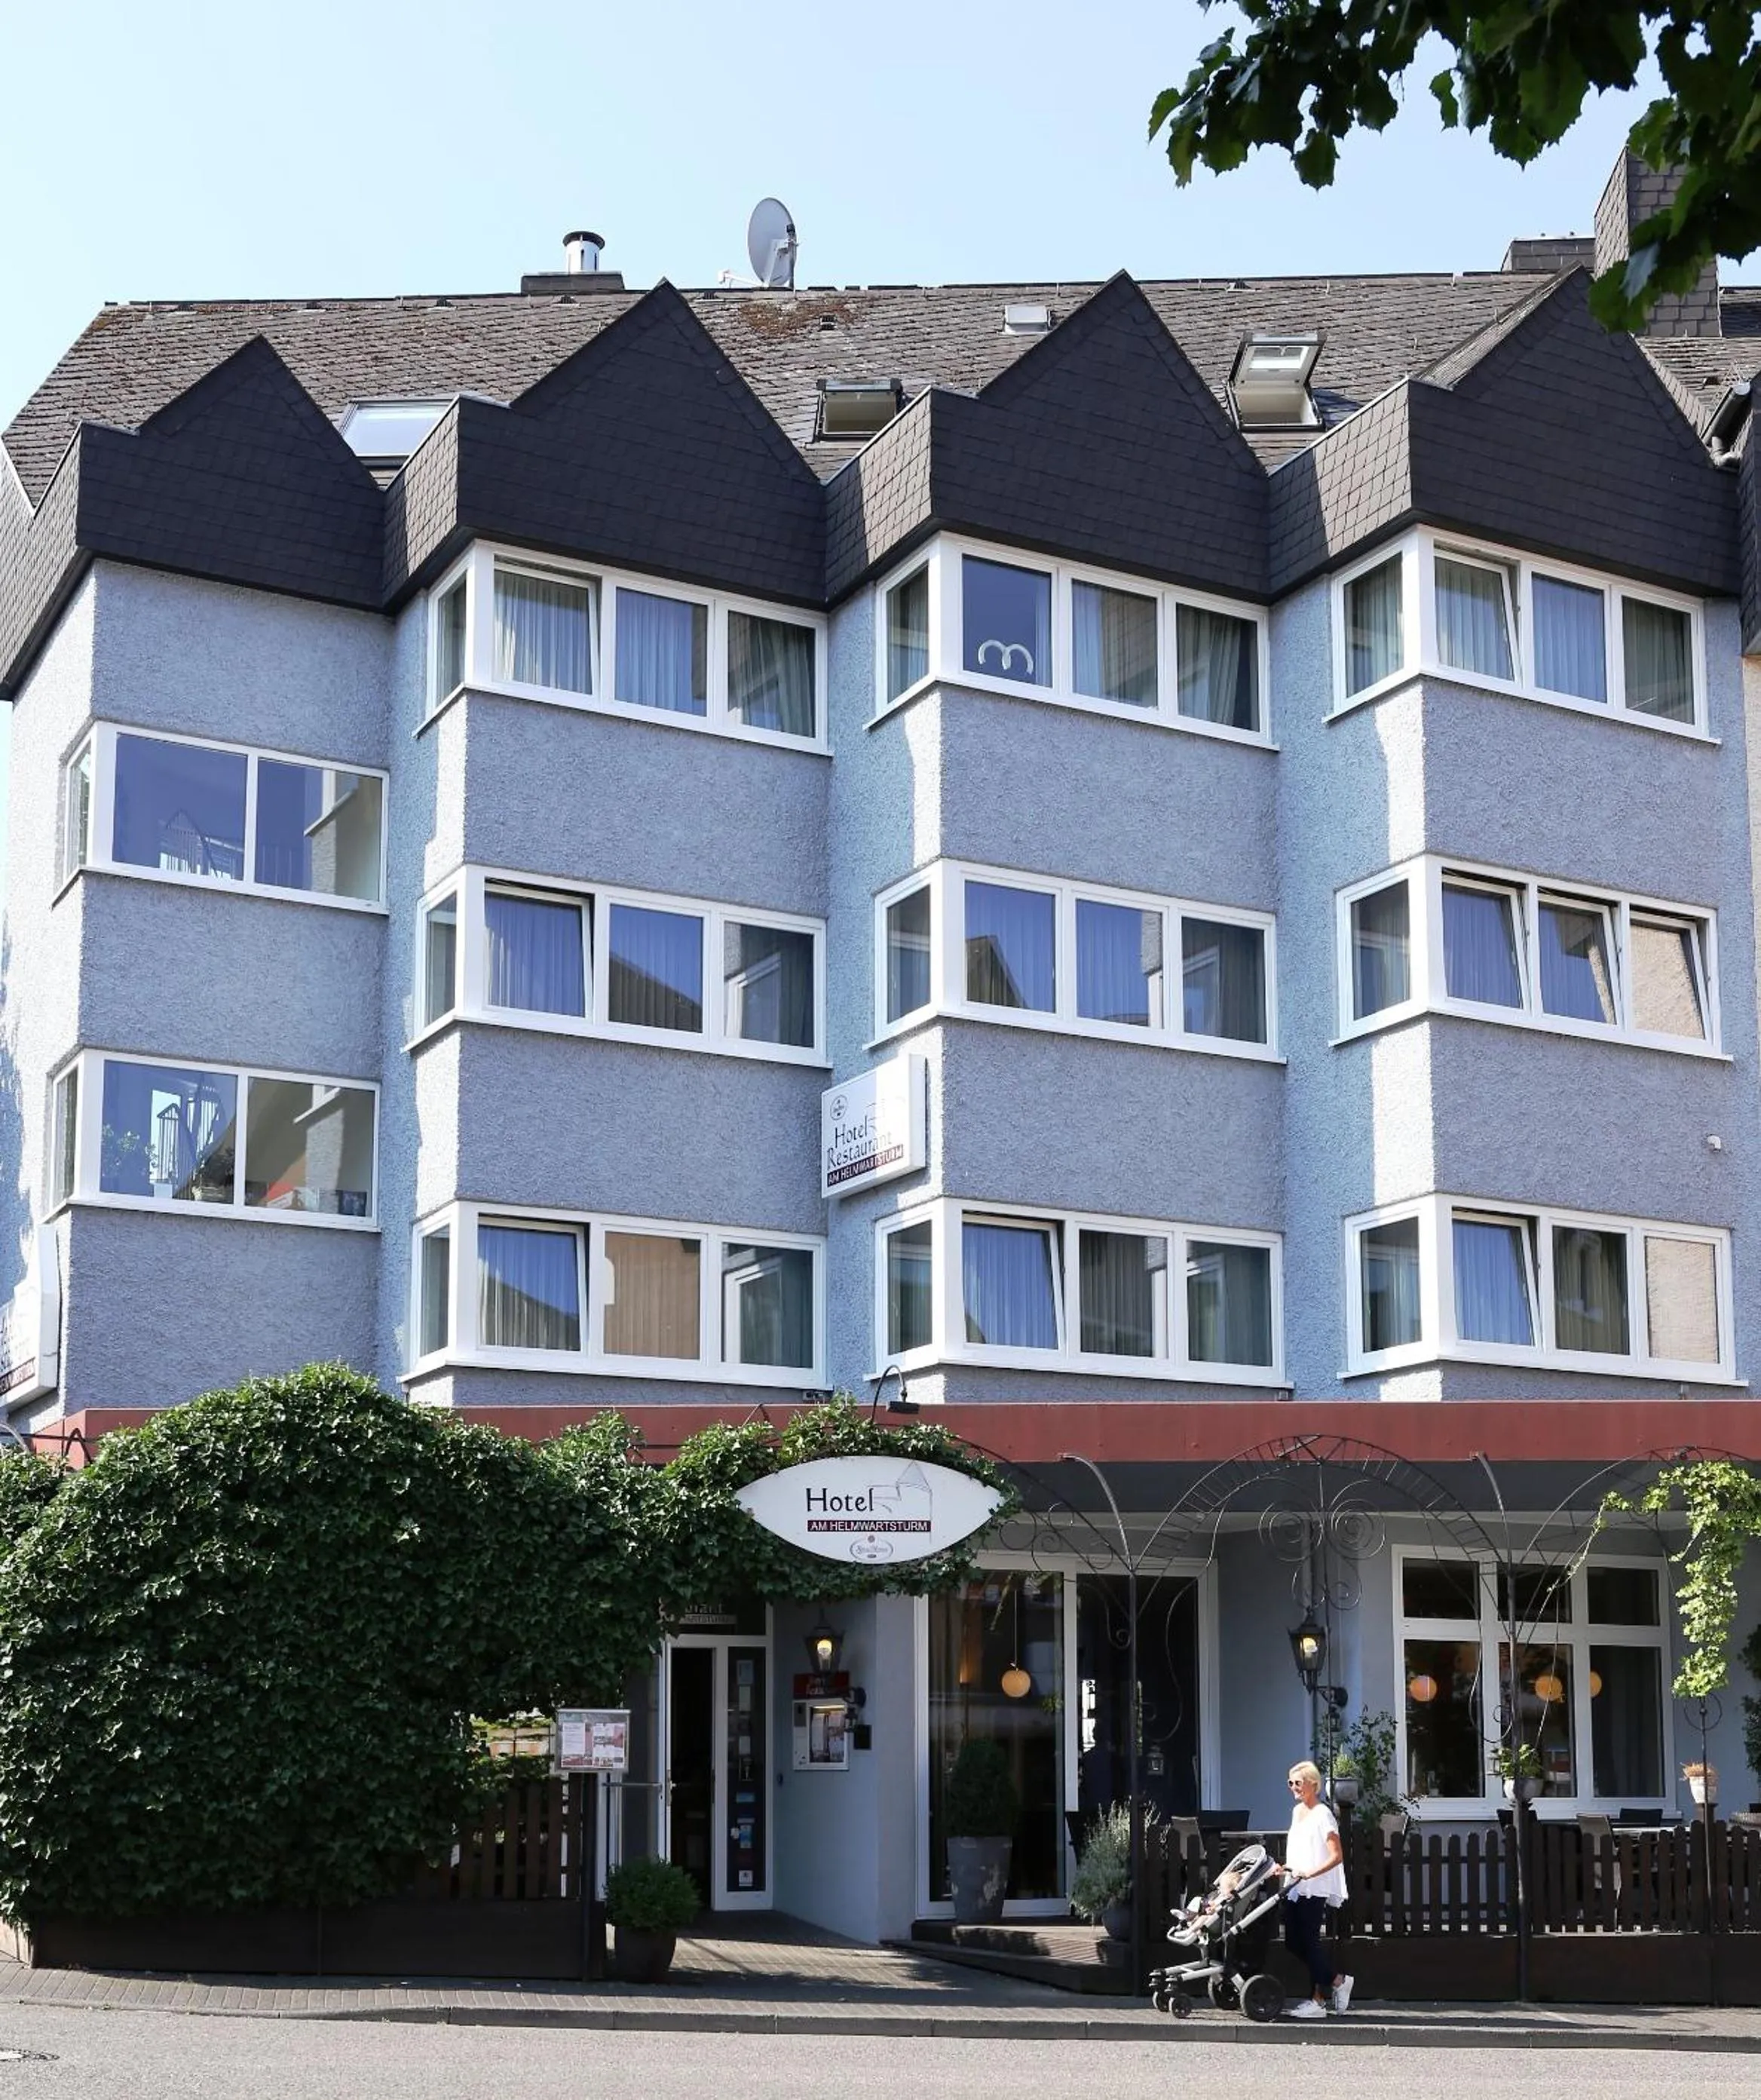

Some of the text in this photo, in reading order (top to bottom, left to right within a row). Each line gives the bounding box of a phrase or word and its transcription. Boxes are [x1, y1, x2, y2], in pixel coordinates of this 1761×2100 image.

[835, 1114, 868, 1148] Hotel
[826, 1131, 893, 1171] Restaurant
[828, 1172, 839, 1184] AM
[806, 1487, 874, 1512] Hotel
[810, 1520, 928, 1532] AM HELMWARTSTURM
